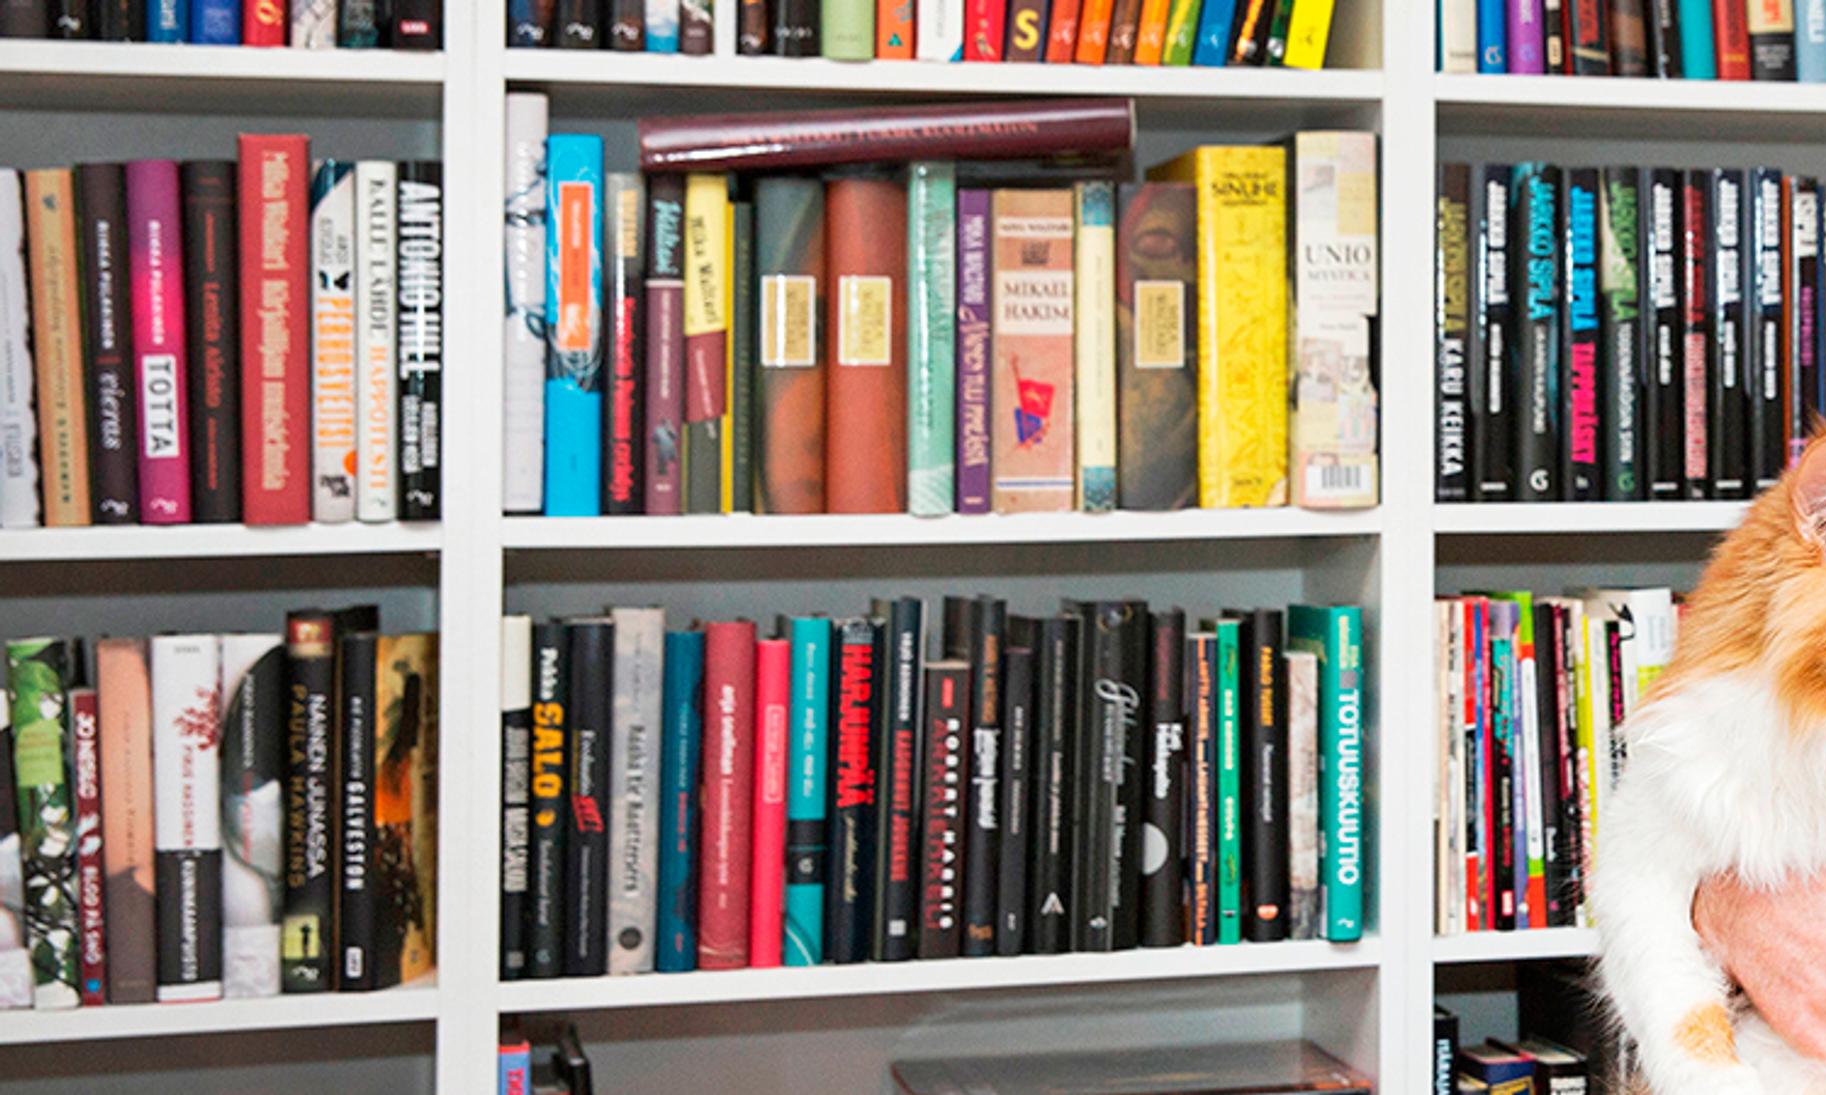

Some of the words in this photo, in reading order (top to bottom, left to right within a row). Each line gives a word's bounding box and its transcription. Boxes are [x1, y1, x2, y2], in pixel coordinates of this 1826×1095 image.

[368, 179, 388, 250] KALLE
[400, 181, 441, 309] ANTONIO
[1304, 245, 1372, 265] UNIO
[368, 261, 392, 338] LÄHDE
[400, 311, 441, 379] HILL
[148, 359, 174, 456] TOTTA
[1441, 338, 1464, 394] KARU
[1572, 342, 1600, 463] TAPPOKÄSKY
[369, 347, 388, 489] HAPPOTESTI
[1441, 401, 1463, 475] KEIKKA
[289, 685, 306, 763] PAULA
[309, 695, 327, 772] NAINEN
[533, 703, 563, 799] SALO
[837, 645, 874, 808] HARJUNPÄÄ
[289, 775, 306, 889] HAWKINS
[308, 778, 327, 878] JUNASSA
[347, 780, 366, 890] GALVESTON
[1338, 689, 1360, 886] TOTUUSKUUTIO
